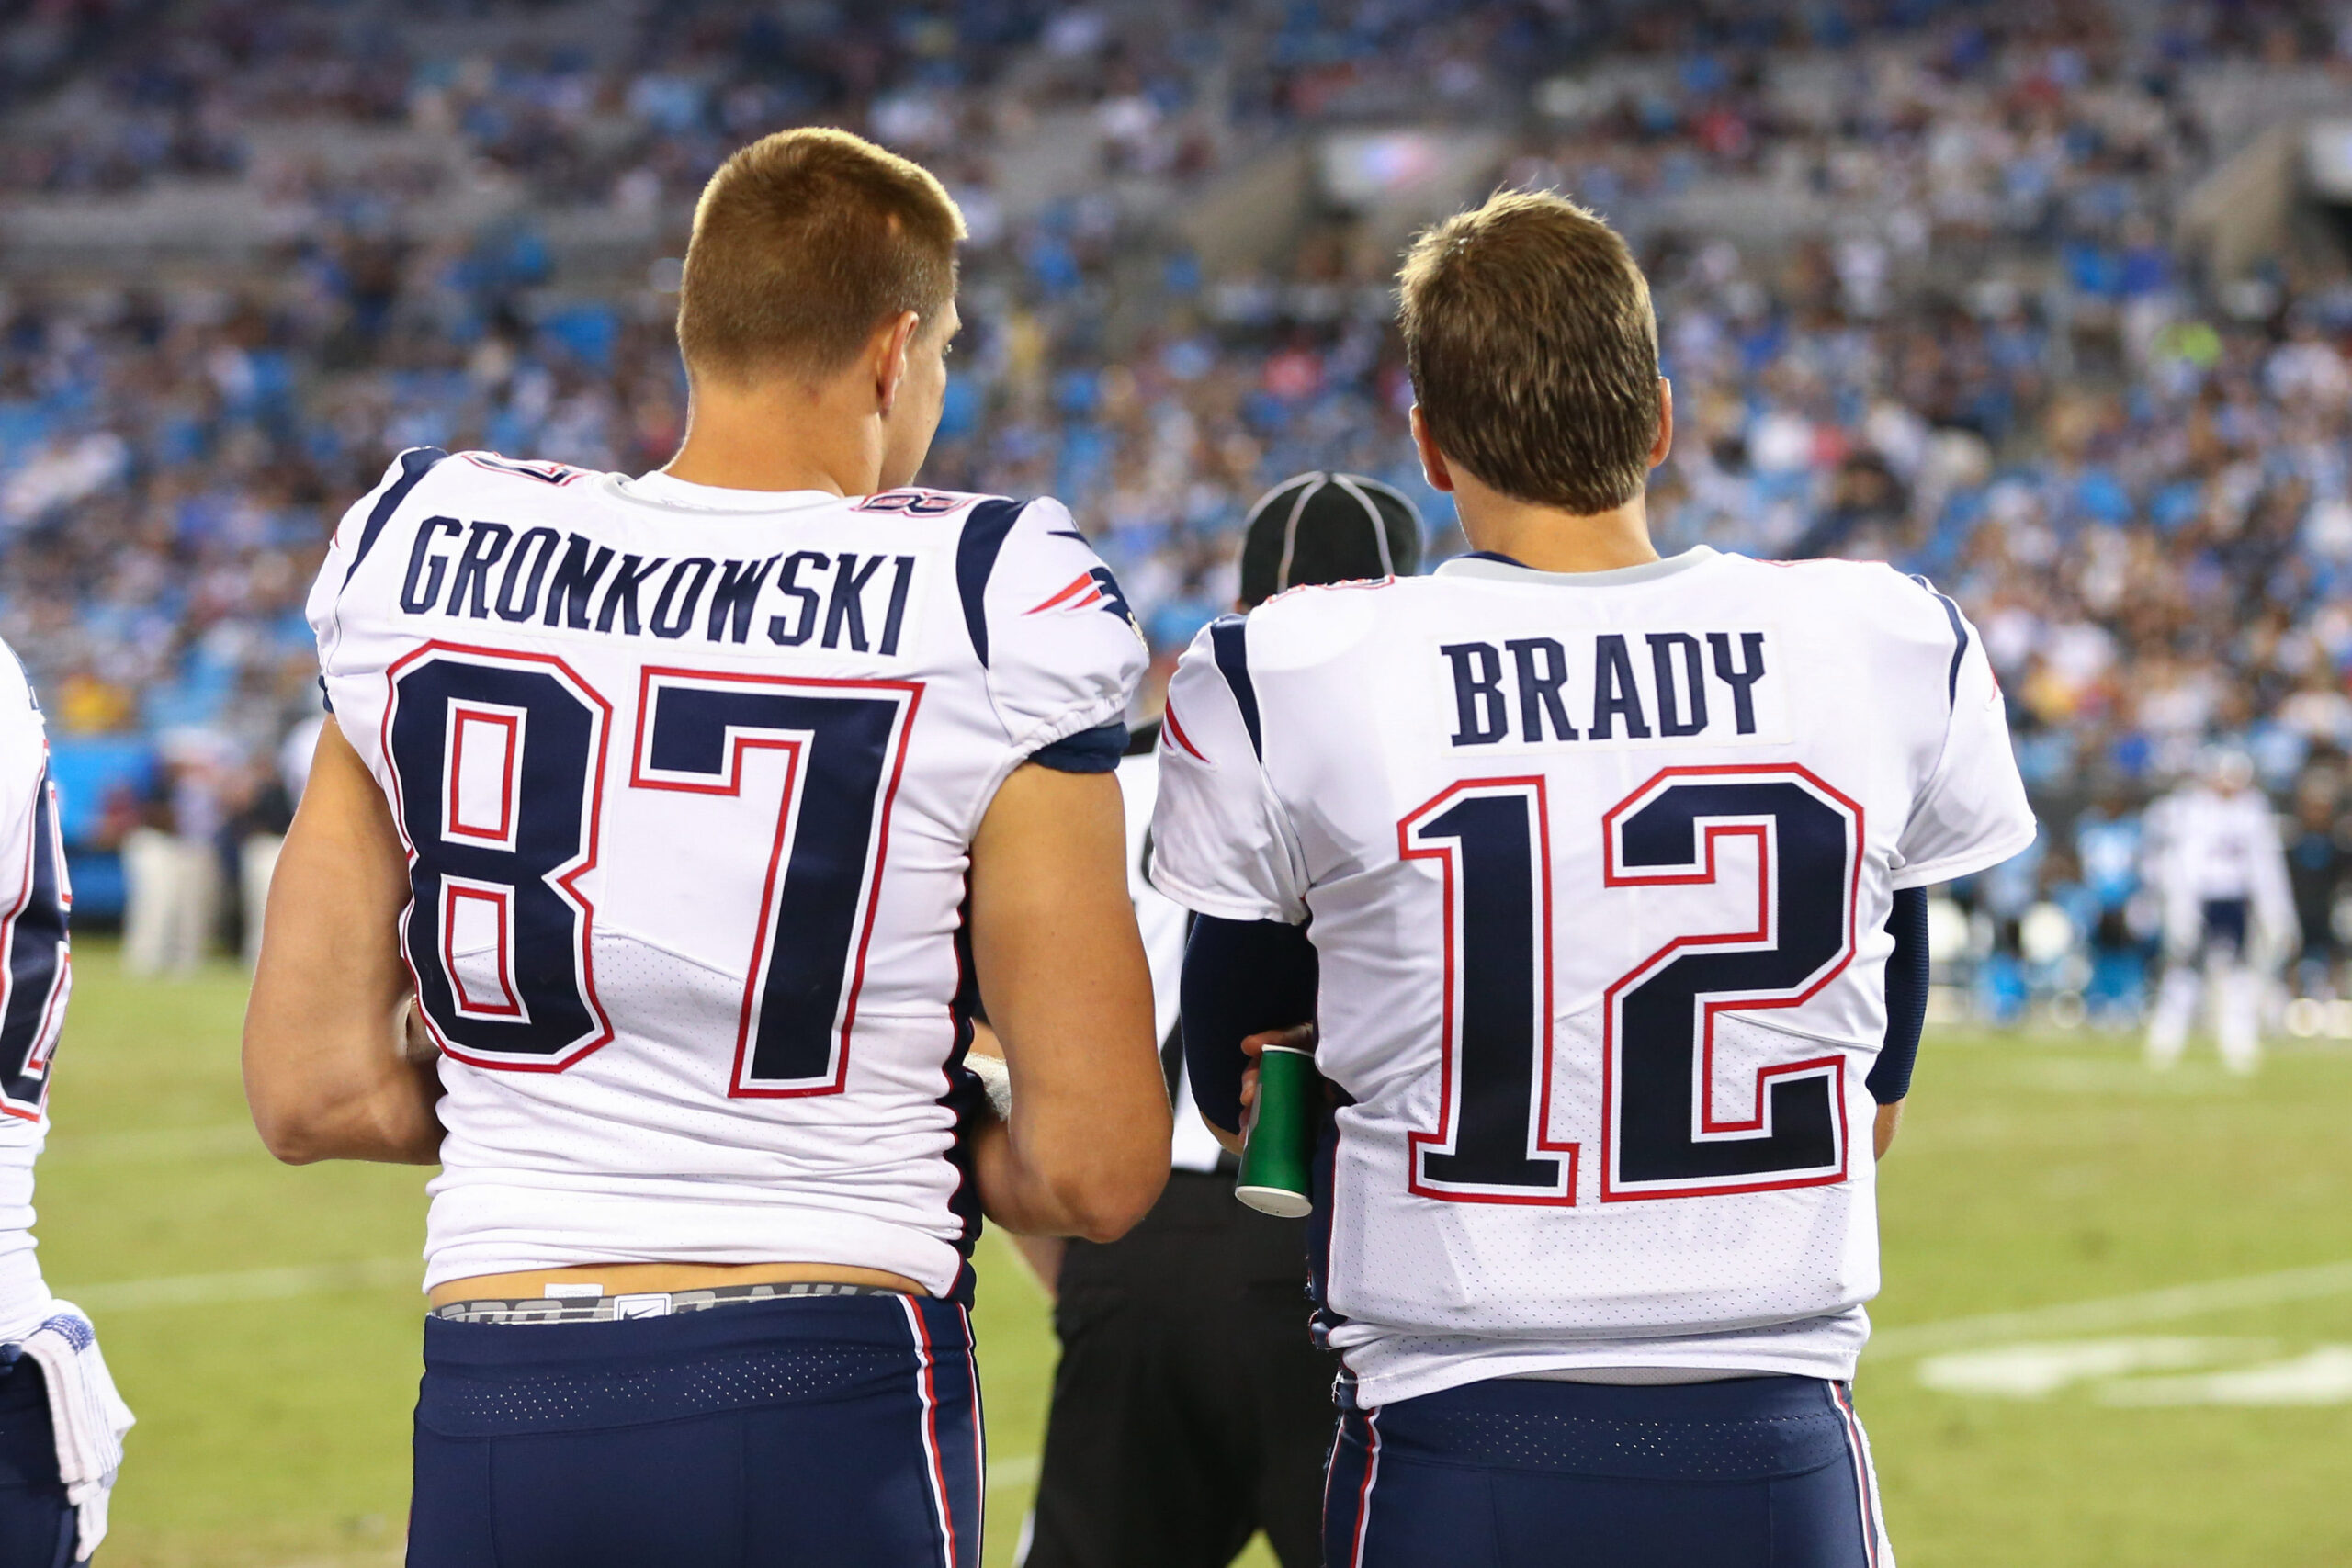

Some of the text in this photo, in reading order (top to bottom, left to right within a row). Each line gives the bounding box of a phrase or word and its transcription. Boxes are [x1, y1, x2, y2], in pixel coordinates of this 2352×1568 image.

[401, 515, 915, 656] GRONKOWSKI
[1440, 632, 1766, 747] BRADY
[382, 638, 926, 1099] 87
[1397, 762, 1864, 1207] 12
